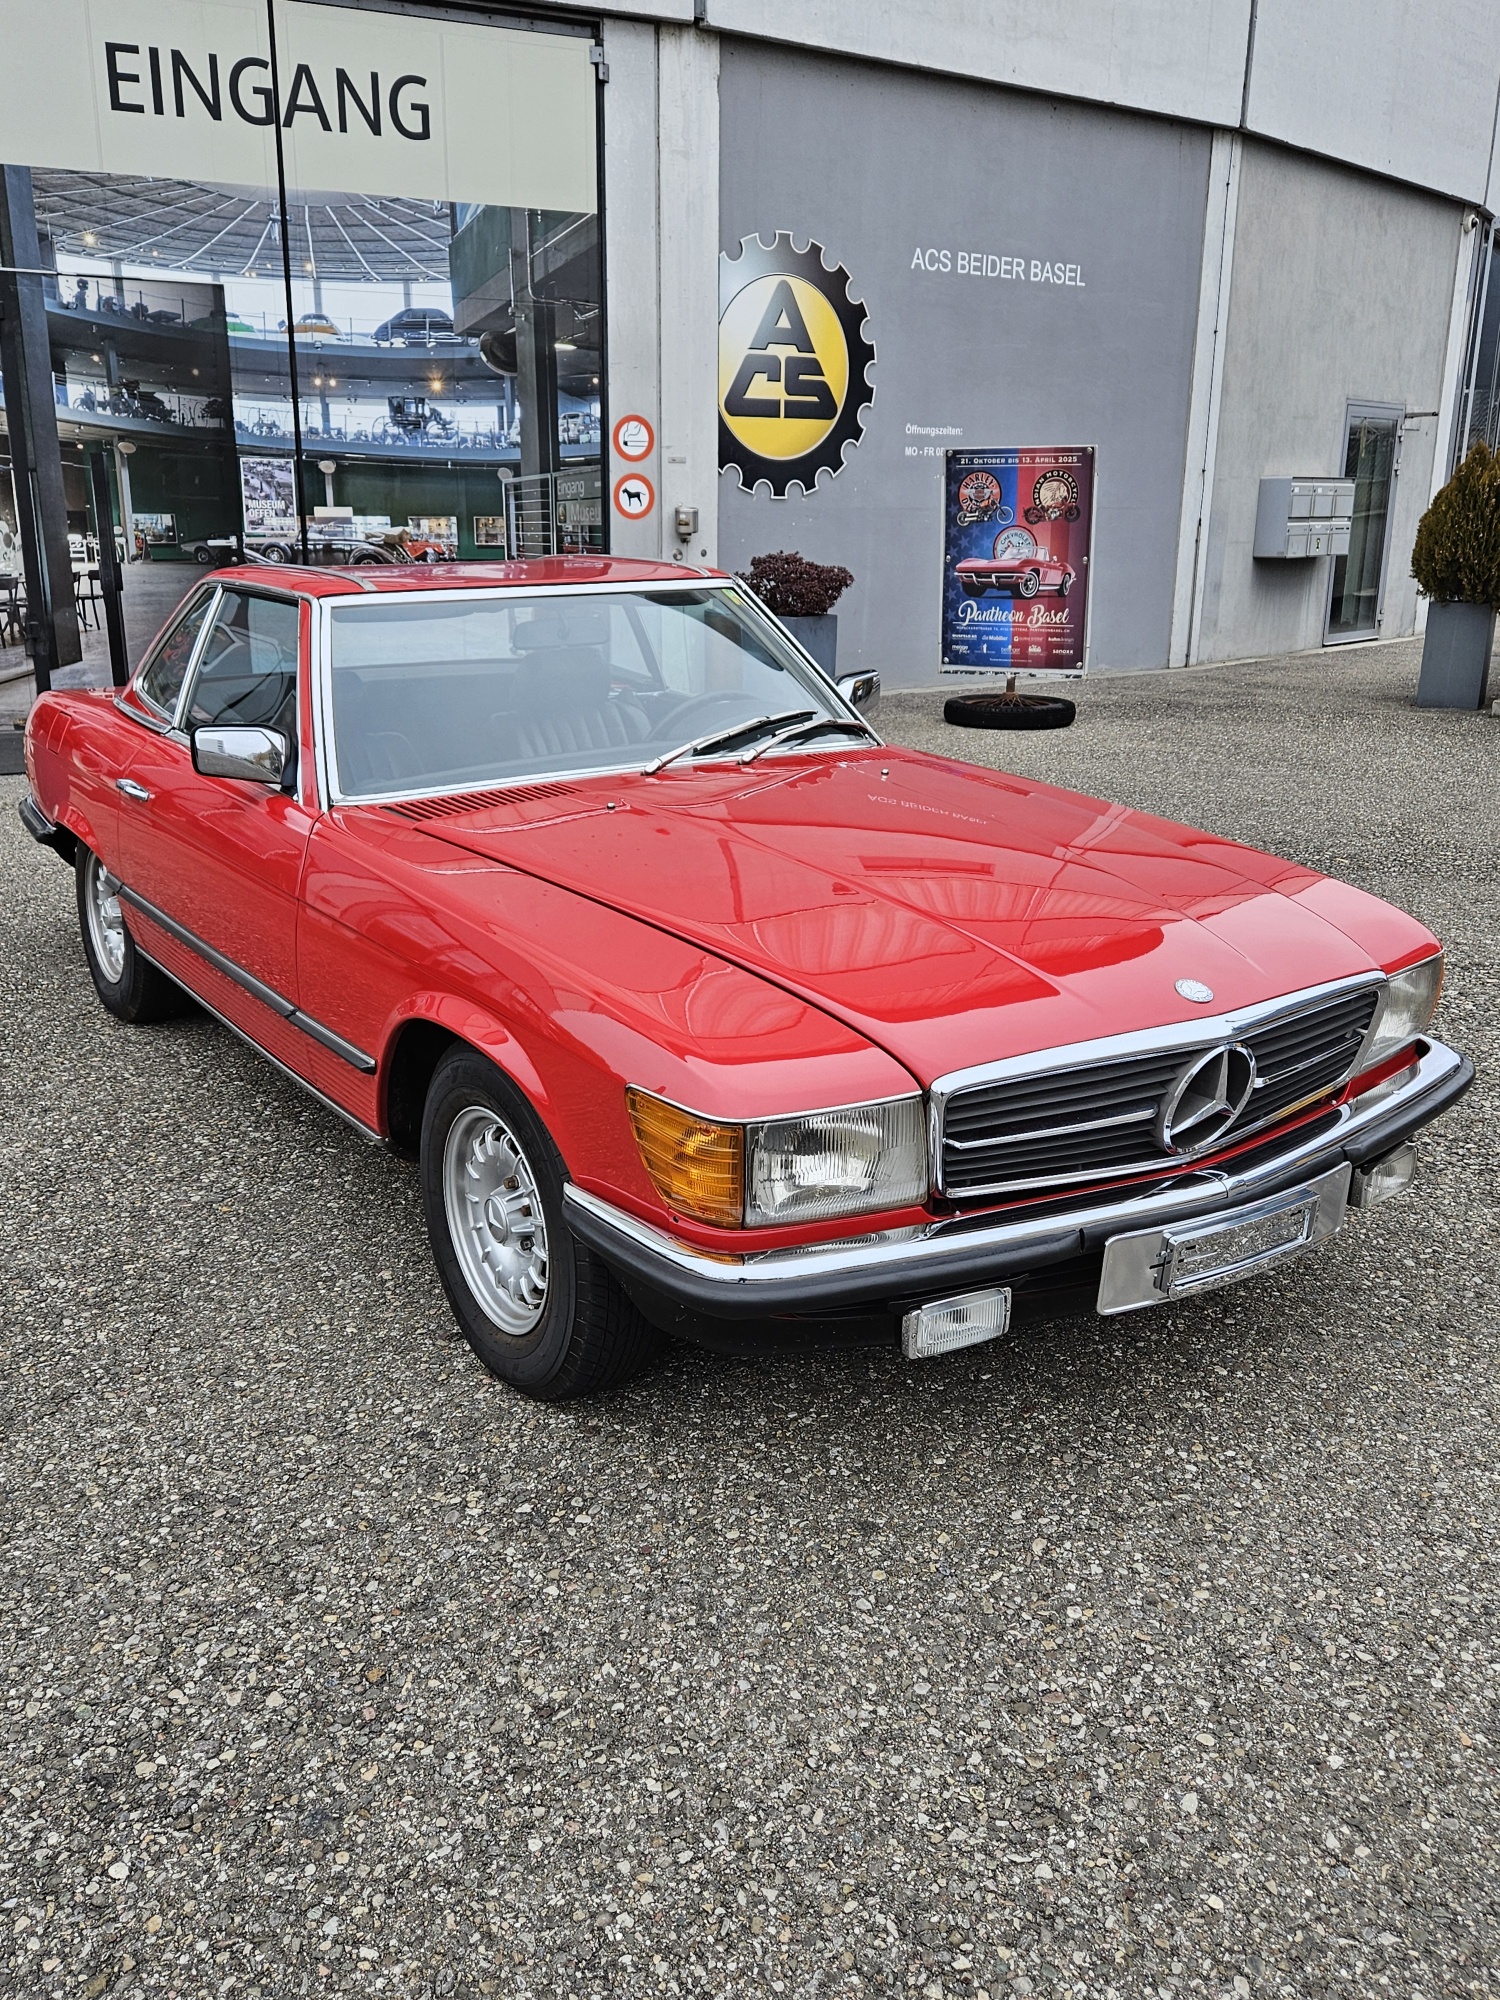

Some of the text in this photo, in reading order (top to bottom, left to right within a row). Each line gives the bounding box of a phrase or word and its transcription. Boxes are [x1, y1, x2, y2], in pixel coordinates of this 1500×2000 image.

[104, 41, 431, 141] EINGANG
[911, 247, 1086, 287] ACS BEIDER BASEL
[905, 423, 963, 436] Öffnungszeiten:
[905, 446, 918, 456] MO
[924, 447, 934, 457] FR
[557, 479, 585, 498] Eingang
[248, 500, 286, 509] MUSEUM
[570, 503, 601, 521] Museu
[249, 509, 275, 518] OFFEN
[1000, 532, 1031, 545] CHEVROLET
[958, 600, 1070, 628] Pantheon Basel
